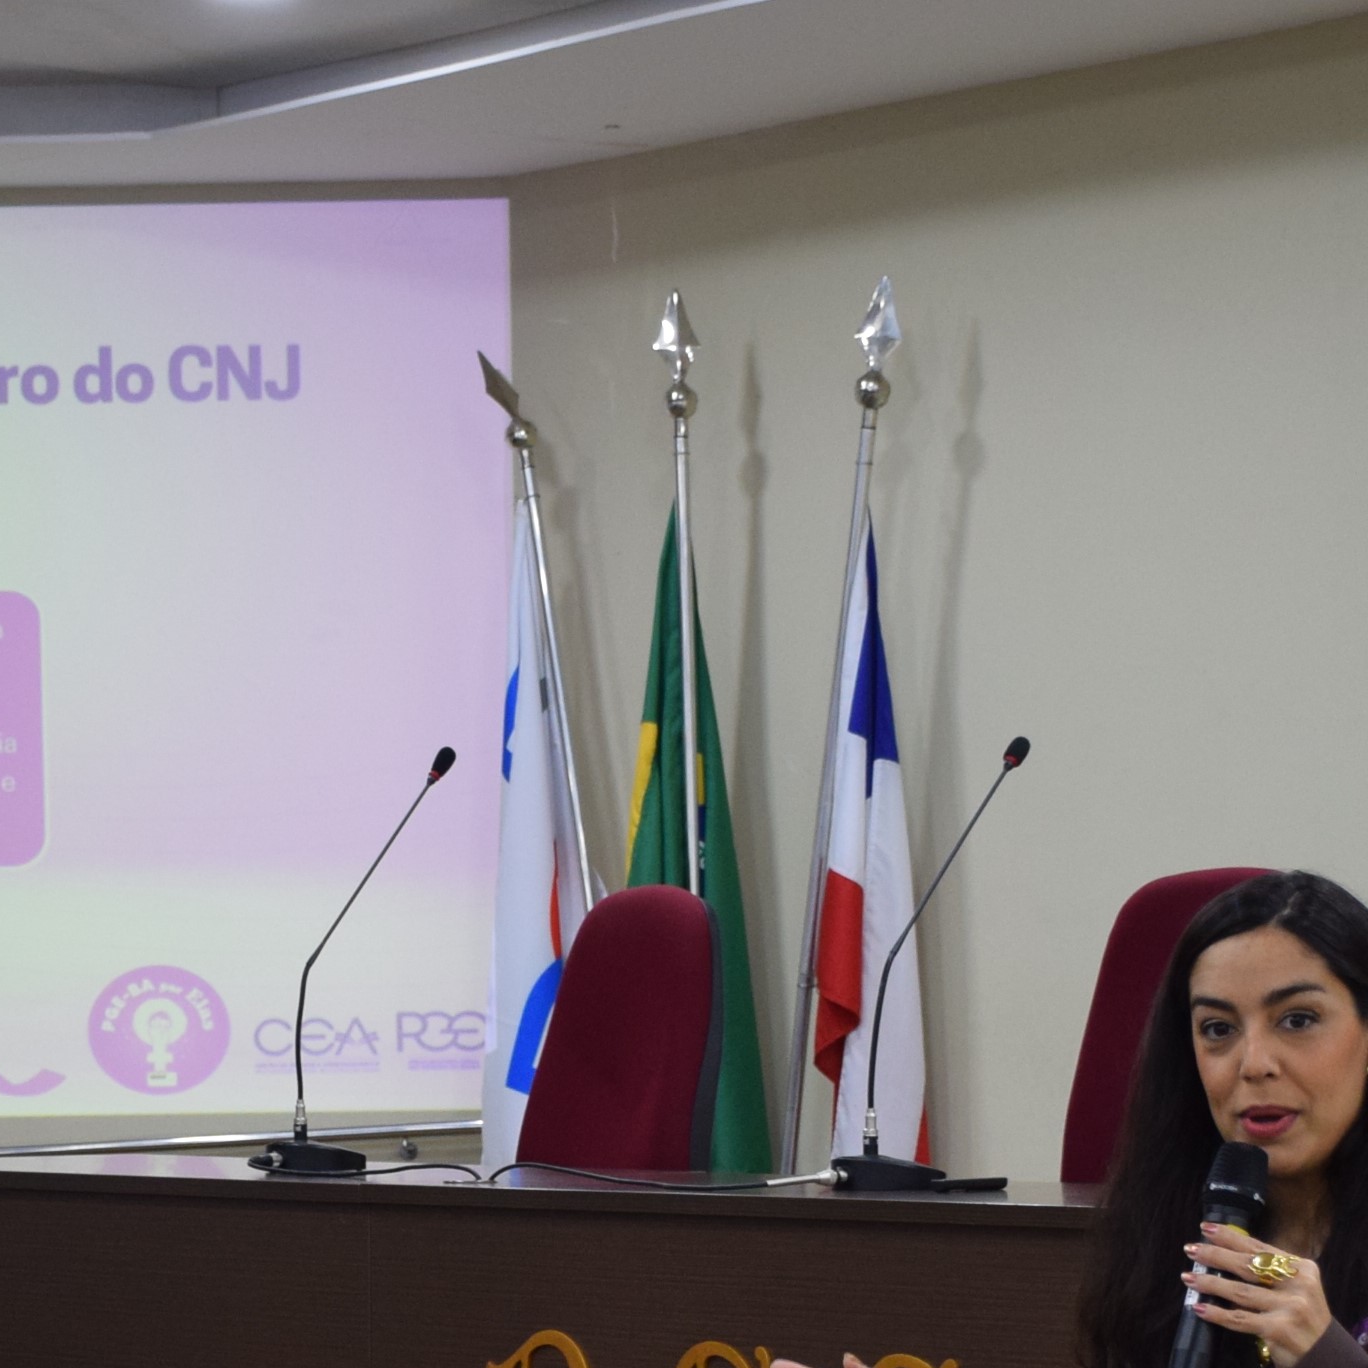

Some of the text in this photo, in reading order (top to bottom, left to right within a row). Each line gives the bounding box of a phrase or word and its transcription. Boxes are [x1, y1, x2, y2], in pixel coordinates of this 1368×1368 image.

[73, 346, 154, 404] do
[168, 344, 302, 402] CNJ
[1, 776, 16, 793] e
